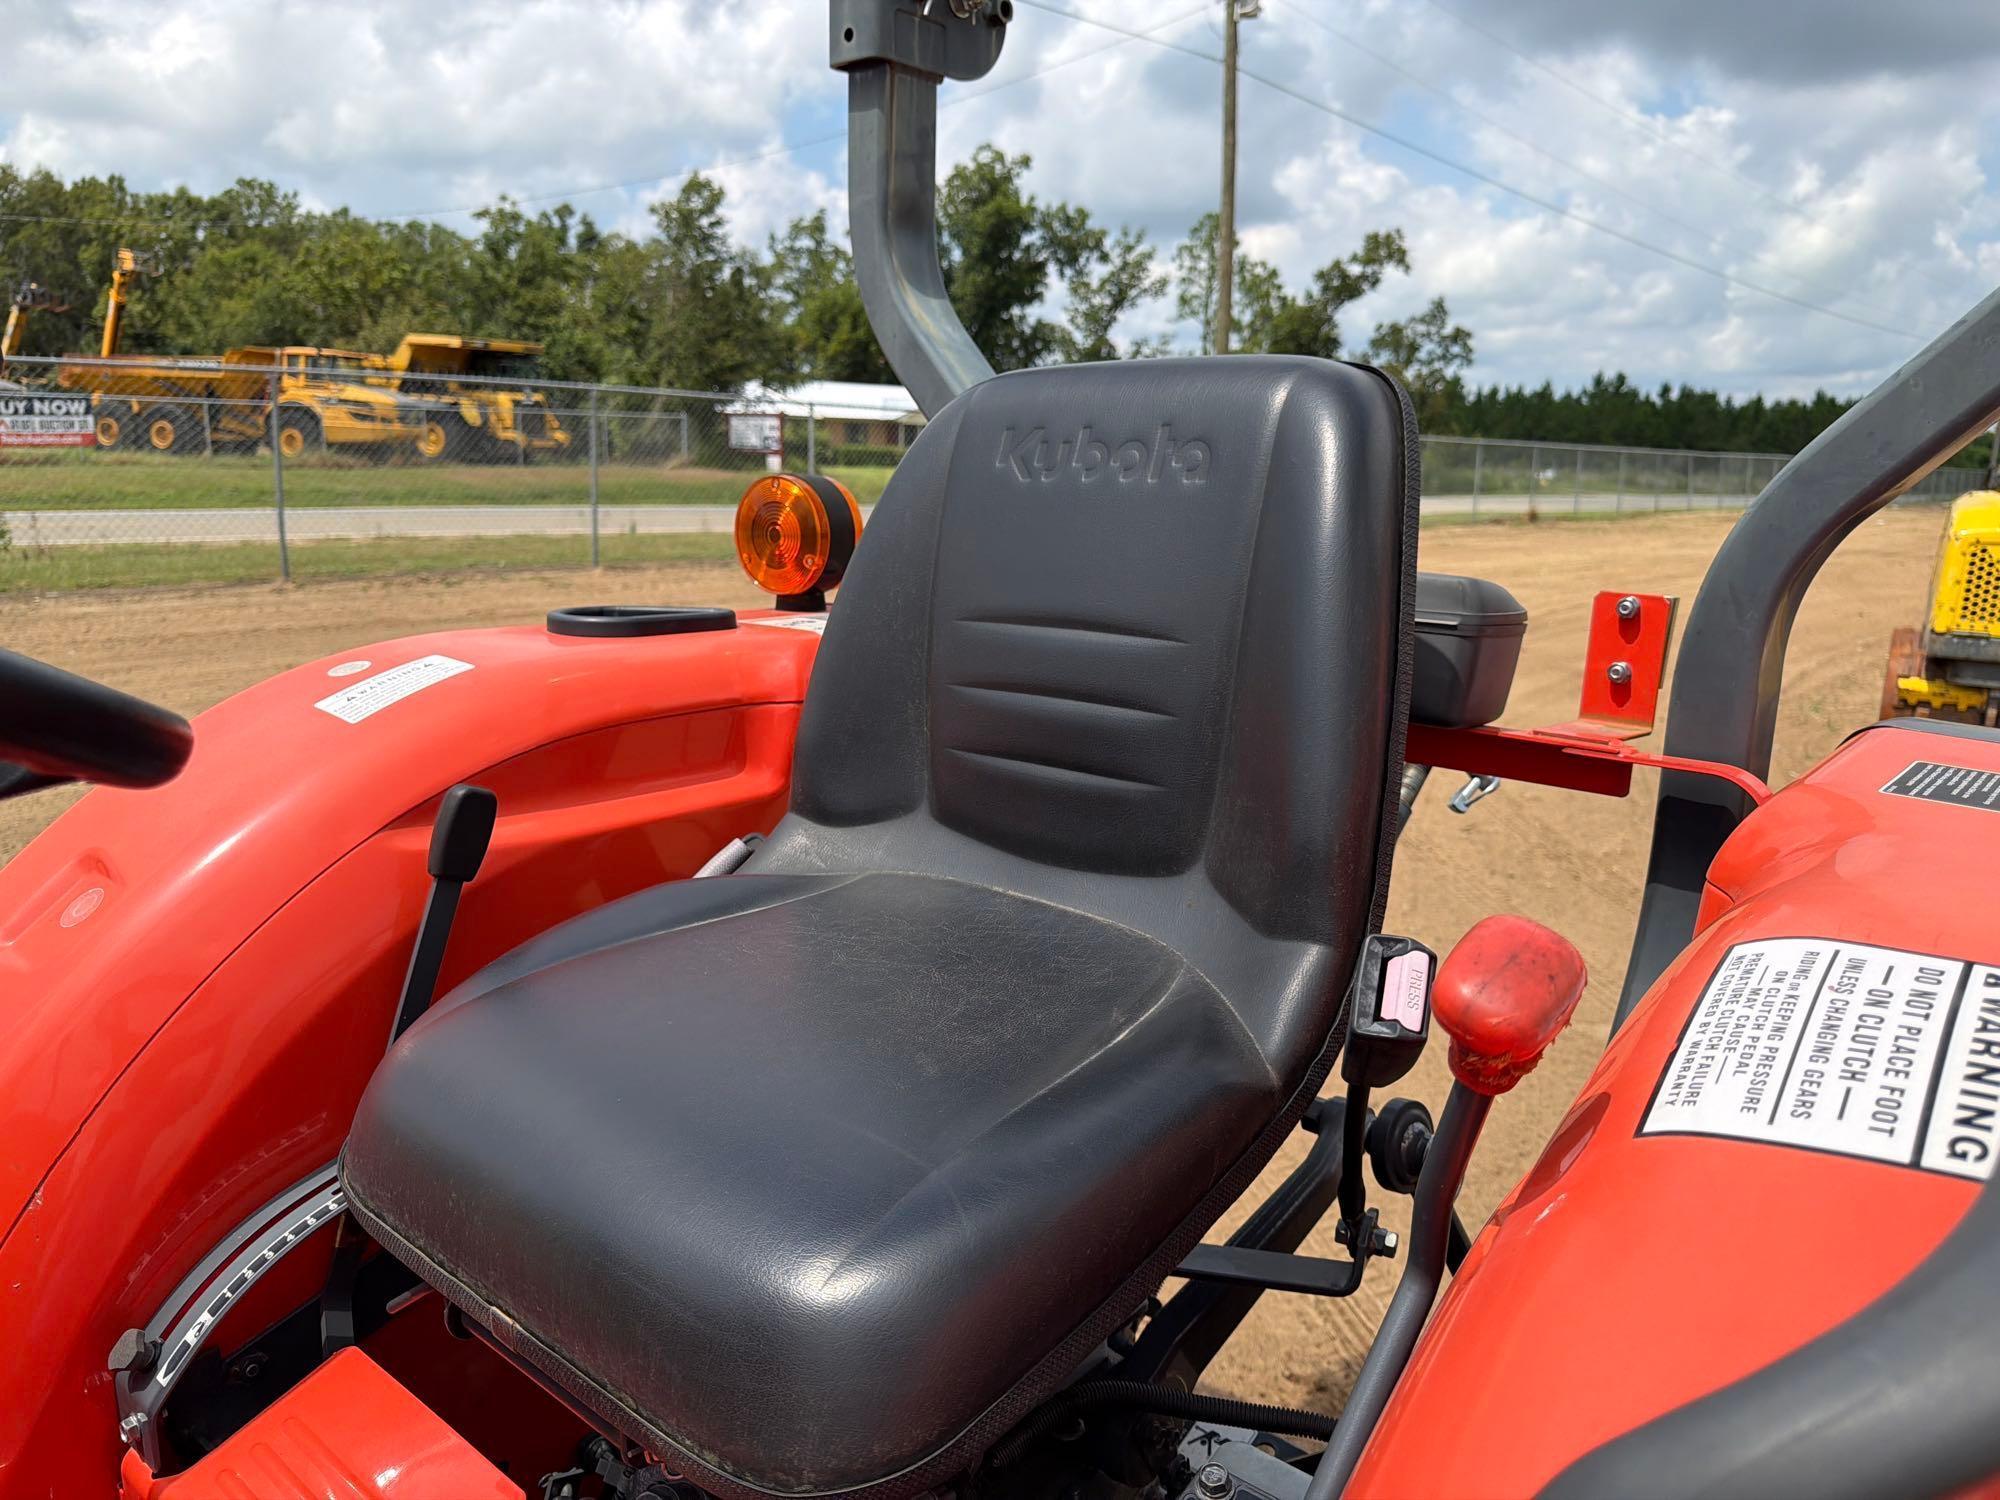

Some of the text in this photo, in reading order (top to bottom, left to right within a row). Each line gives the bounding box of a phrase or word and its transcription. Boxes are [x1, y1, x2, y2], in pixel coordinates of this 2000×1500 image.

[33, 399, 87, 415] NOW
[995, 421, 1211, 483] Kubota
[1406, 968, 1424, 1011] PRESS
[1793, 951, 1820, 980] RIDING
[1665, 955, 1747, 1106] NOT COVERED BY WARRANTY
[1682, 953, 1764, 1107] PREMATURE CLUTCH FAILURE
[1723, 988, 1763, 1053] MAY CAUSE
[1733, 971, 1789, 1077] ON CLUTCH PEDAL
[1767, 994, 1800, 1041] KEEPING
[1790, 958, 1867, 1120] UNLESS CHANGING GEARS
[1839, 989, 1894, 1083] ON CLUTCH
[1740, 1046, 1779, 1114] PRESSURE
[1868, 967, 1945, 1137] DO NOT PLACE FOOT
